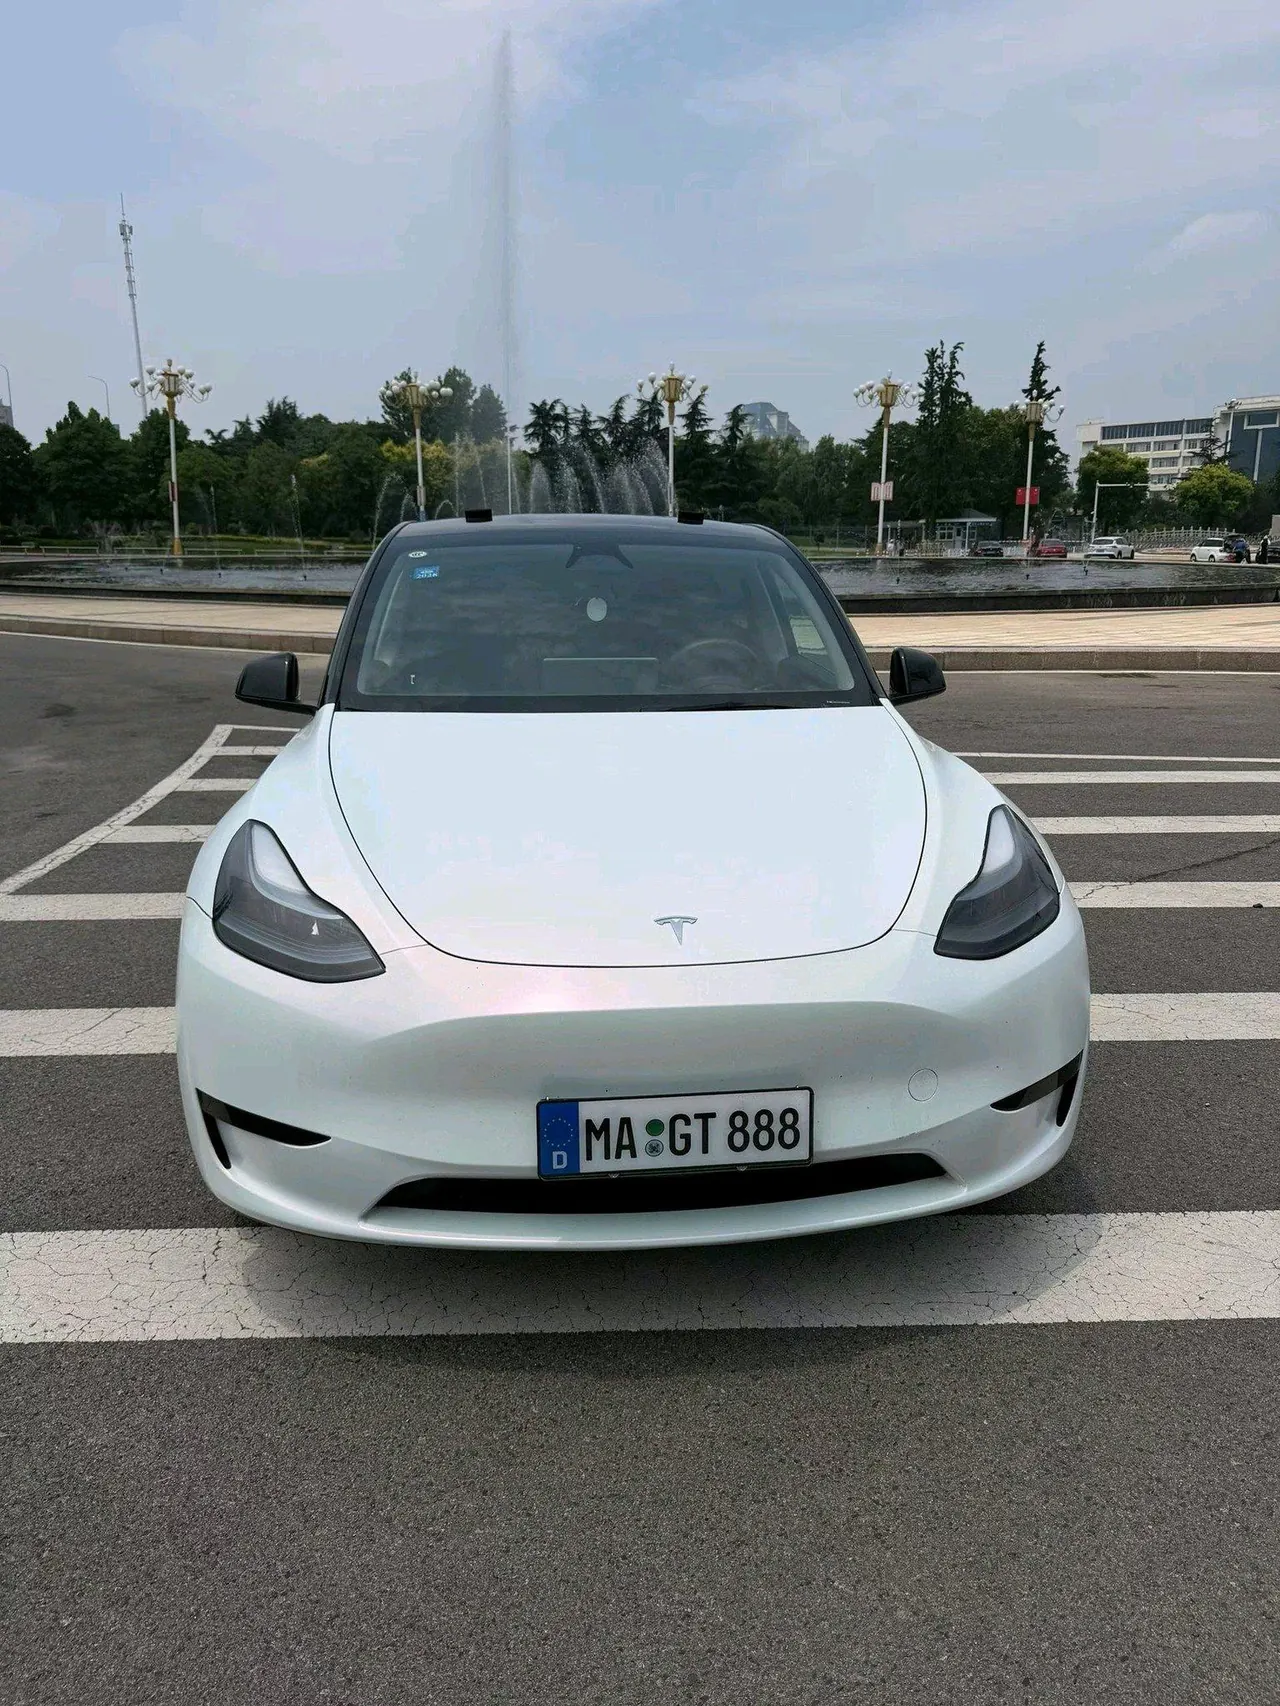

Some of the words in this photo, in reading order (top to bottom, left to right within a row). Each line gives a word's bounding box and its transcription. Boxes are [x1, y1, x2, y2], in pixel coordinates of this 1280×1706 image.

[585, 1117, 637, 1161] MA
[669, 1112, 717, 1156] GT
[727, 1107, 800, 1153] 888
[552, 1151, 567, 1169] D
